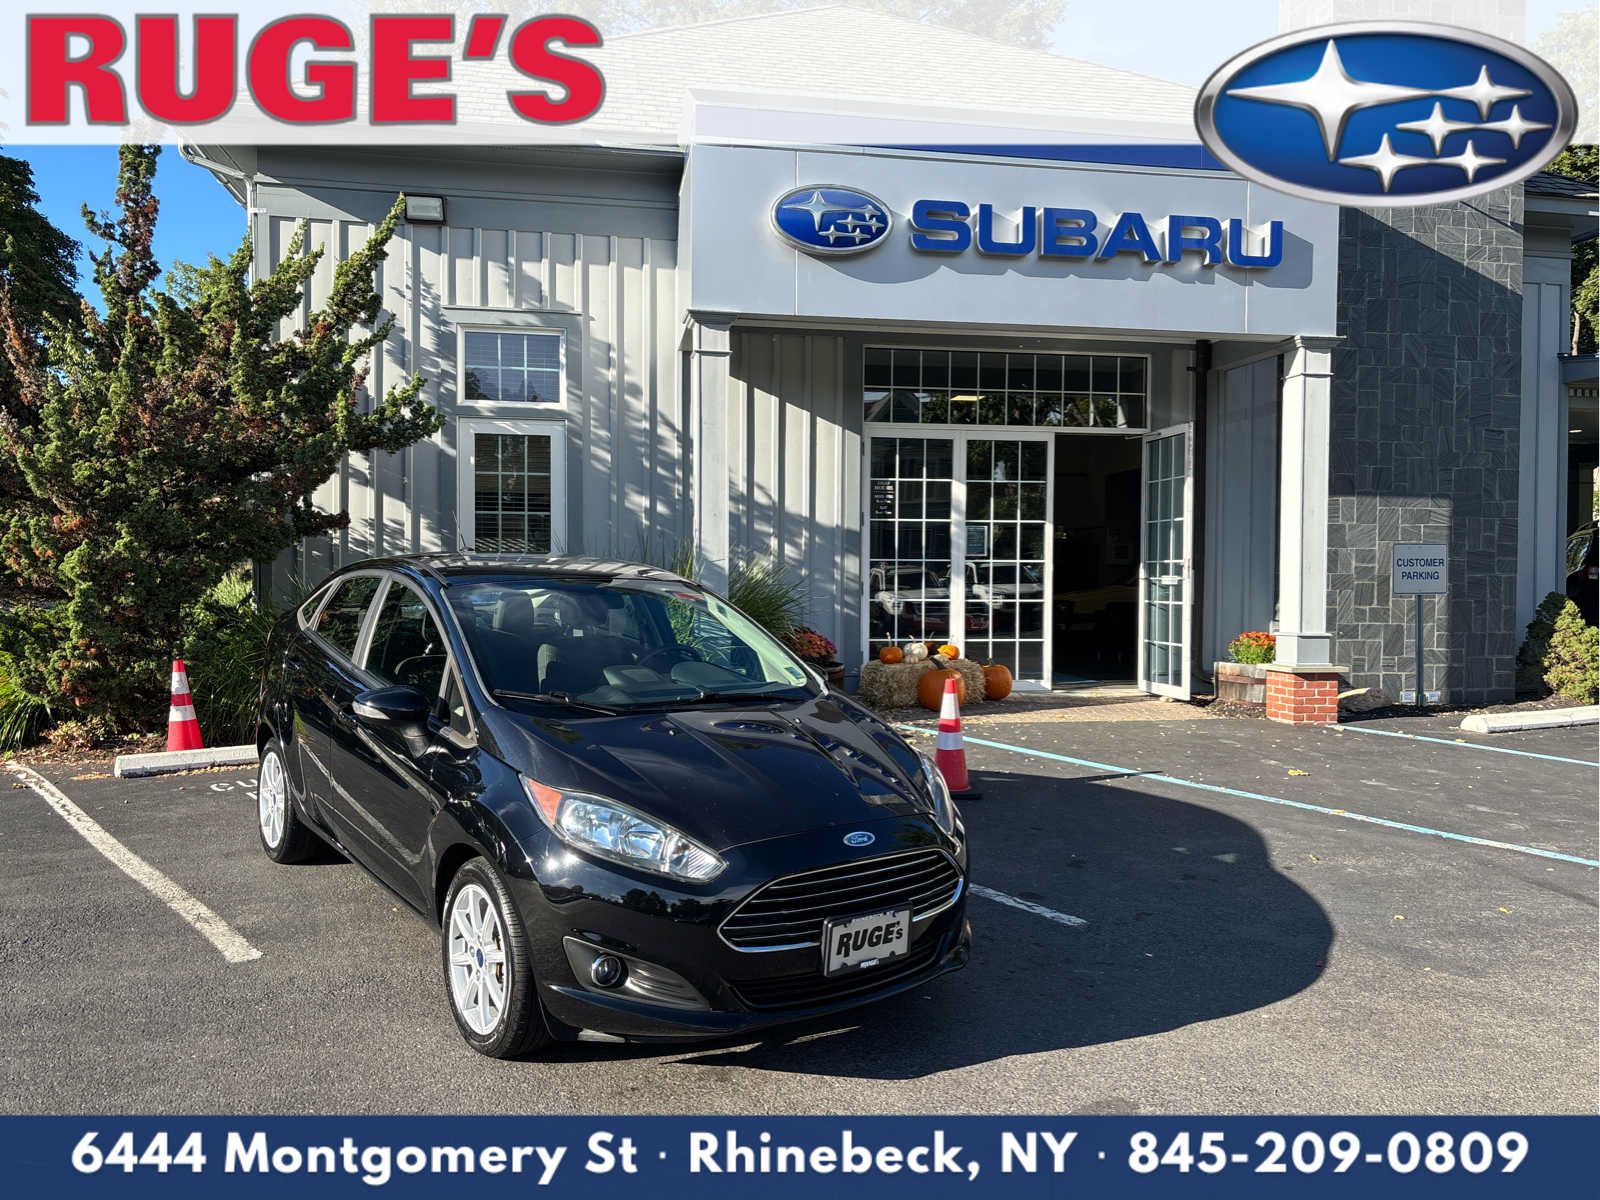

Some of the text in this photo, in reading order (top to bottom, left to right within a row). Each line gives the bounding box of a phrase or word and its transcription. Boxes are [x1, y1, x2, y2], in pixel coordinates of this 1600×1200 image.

[910, 198, 1284, 269] SUBARU
[1396, 558, 1445, 567] CUSTOMER
[1401, 571, 1440, 580] PARKING
